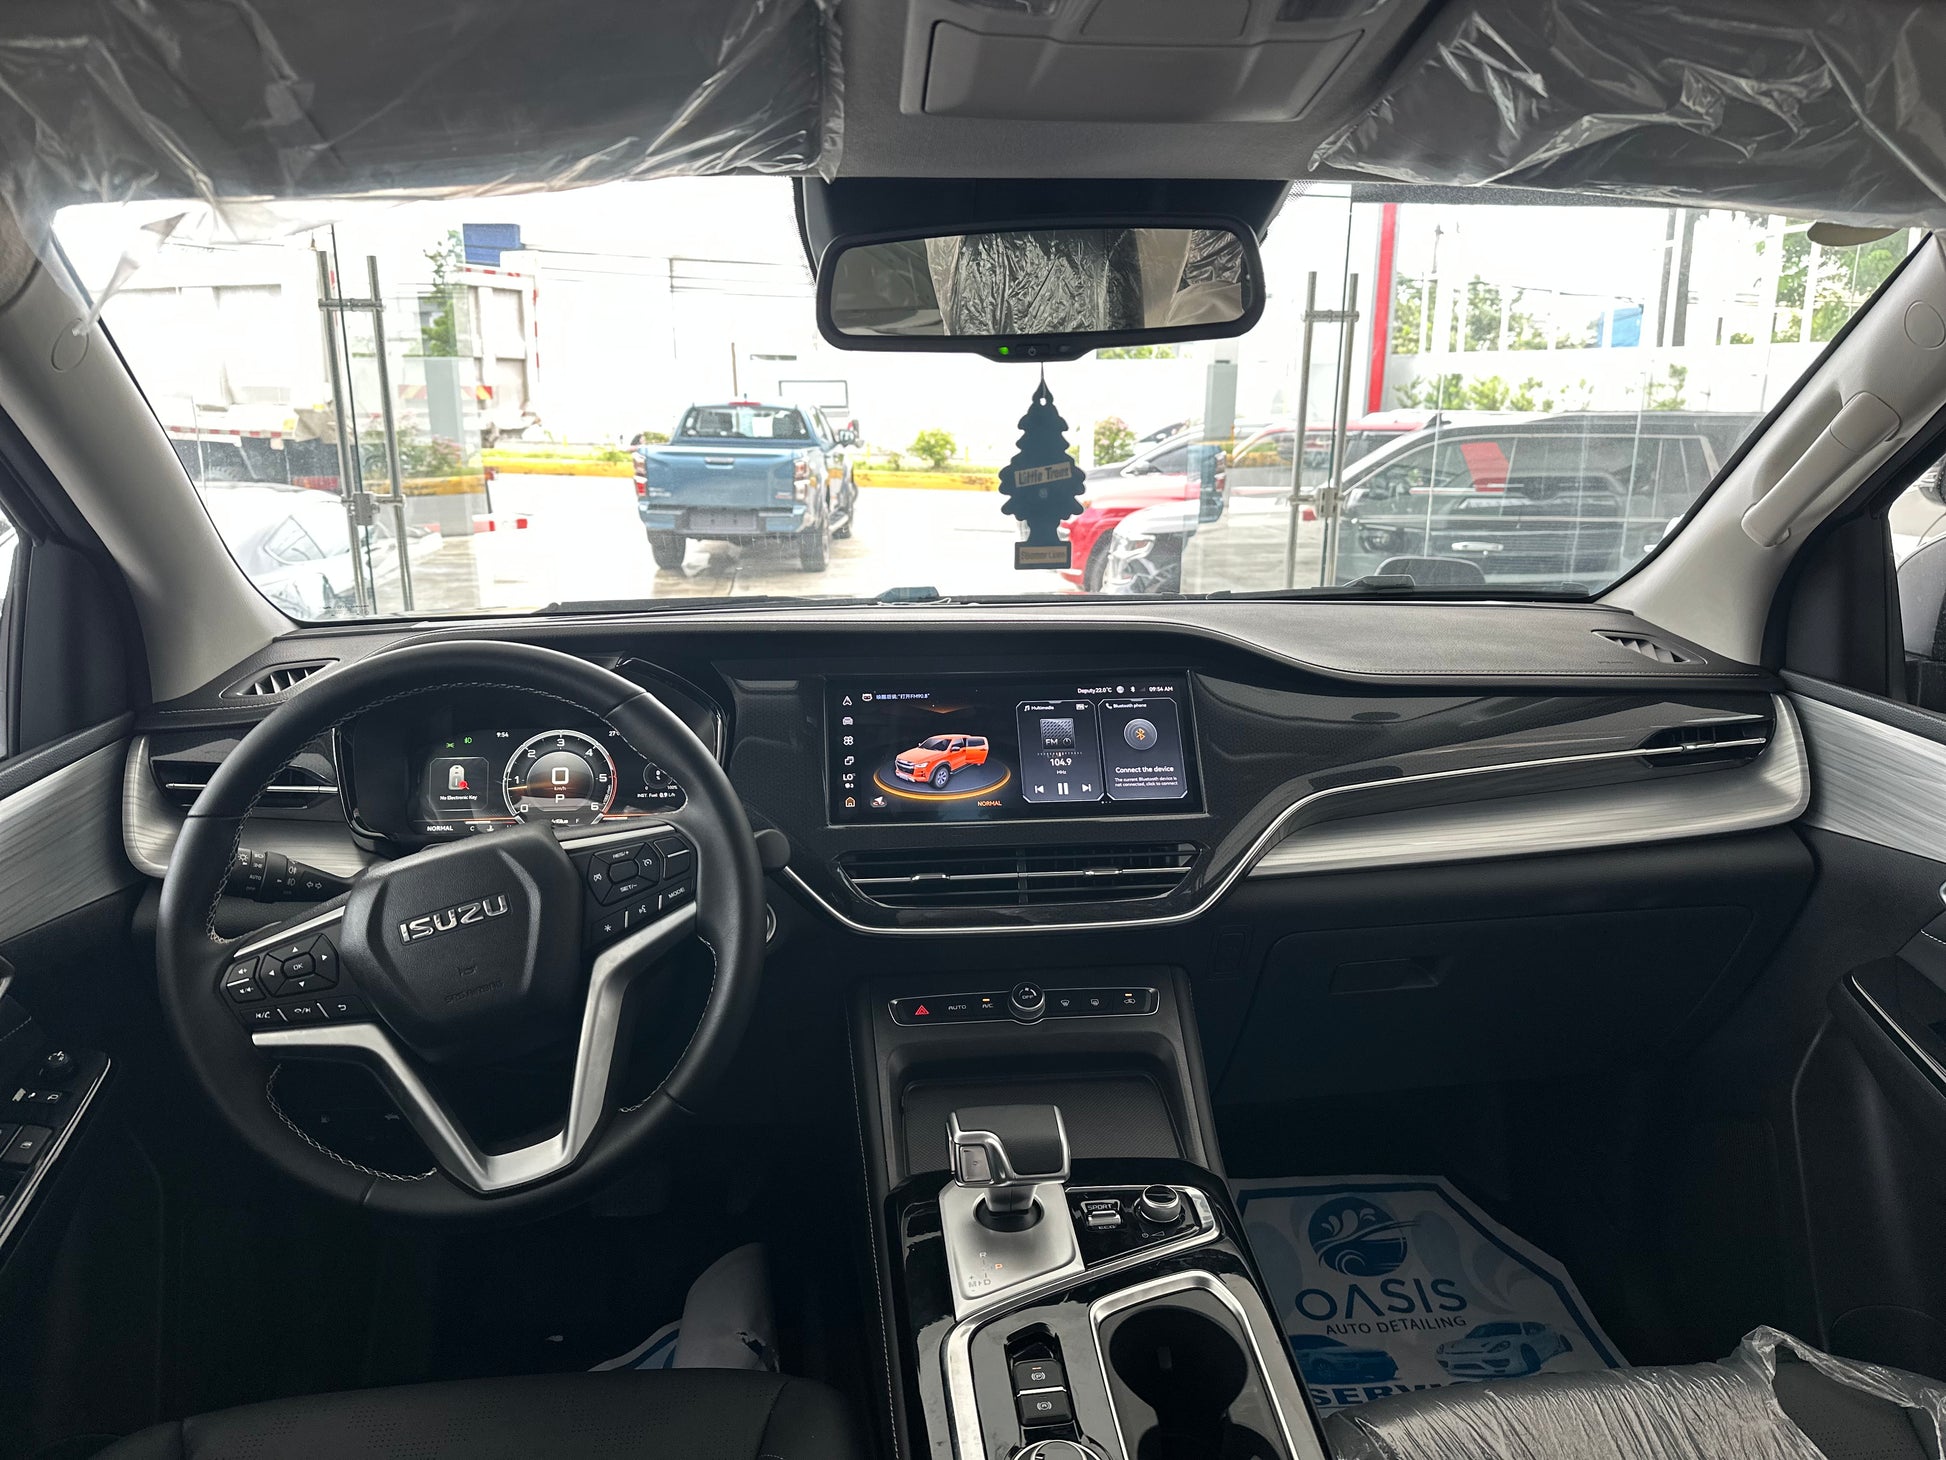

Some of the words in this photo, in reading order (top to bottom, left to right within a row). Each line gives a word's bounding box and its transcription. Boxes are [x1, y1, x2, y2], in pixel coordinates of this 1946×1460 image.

[556, 739, 565, 747] 3
[1045, 738, 1058, 746] FM
[527, 749, 536, 758] 2
[585, 749, 594, 757] 4
[1050, 758, 1072, 767] 104.9
[1115, 766, 1141, 774] Connect
[514, 776, 520, 784] 1
[552, 767, 569, 785] 0
[598, 773, 608, 782] 5
[555, 794, 565, 804] P
[520, 804, 529, 813] 0
[591, 802, 599, 811] 6
[668, 887, 685, 898] MODE
[399, 895, 509, 942] ISUZU
[293, 962, 303, 970] OK
[1295, 1278, 1467, 1321] OASIS
[1326, 1322, 1371, 1335] AUTO
[1376, 1315, 1467, 1333] DETAILING
